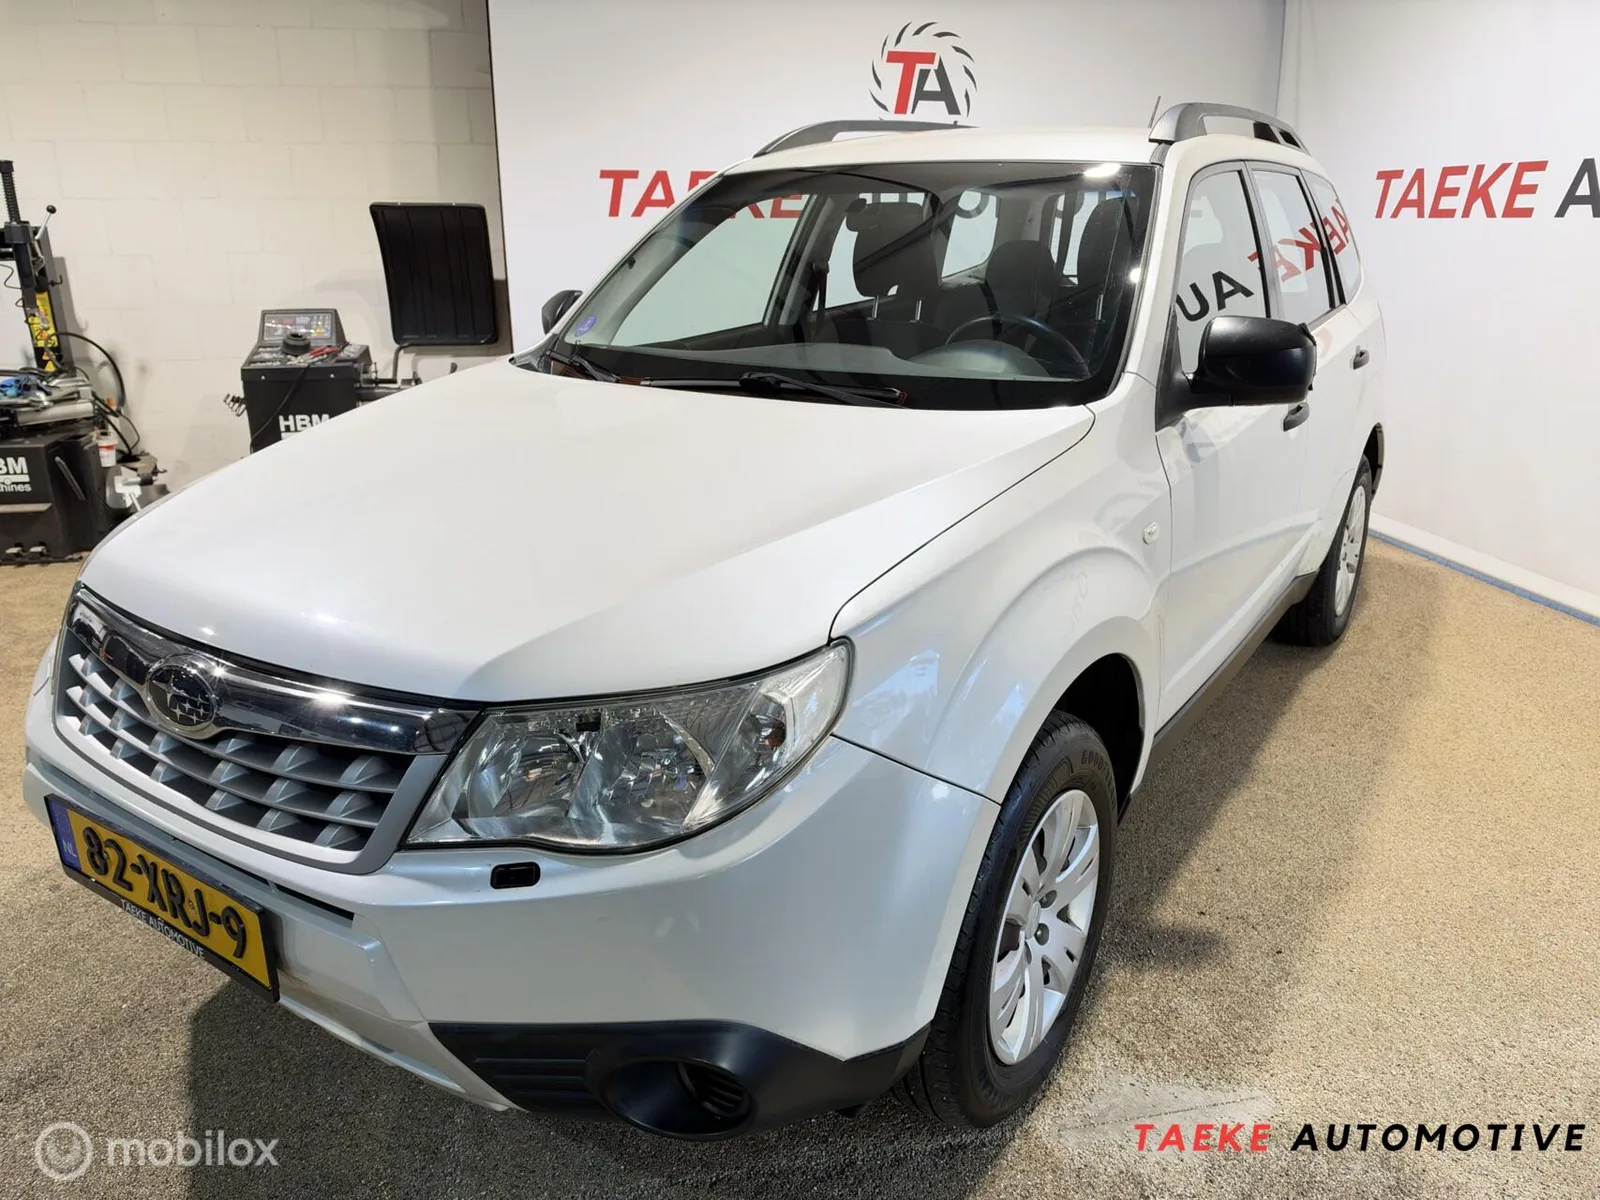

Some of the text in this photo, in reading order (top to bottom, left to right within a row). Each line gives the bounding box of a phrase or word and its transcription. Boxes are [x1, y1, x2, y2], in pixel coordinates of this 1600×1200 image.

[886, 51, 961, 115] TA
[1375, 160, 1549, 218] TAEKE
[62, 839, 77, 857] NL
[82, 826, 247, 960] 82-XRJ-9
[120, 899, 205, 958] TAEKE AUTOMOTIVE
